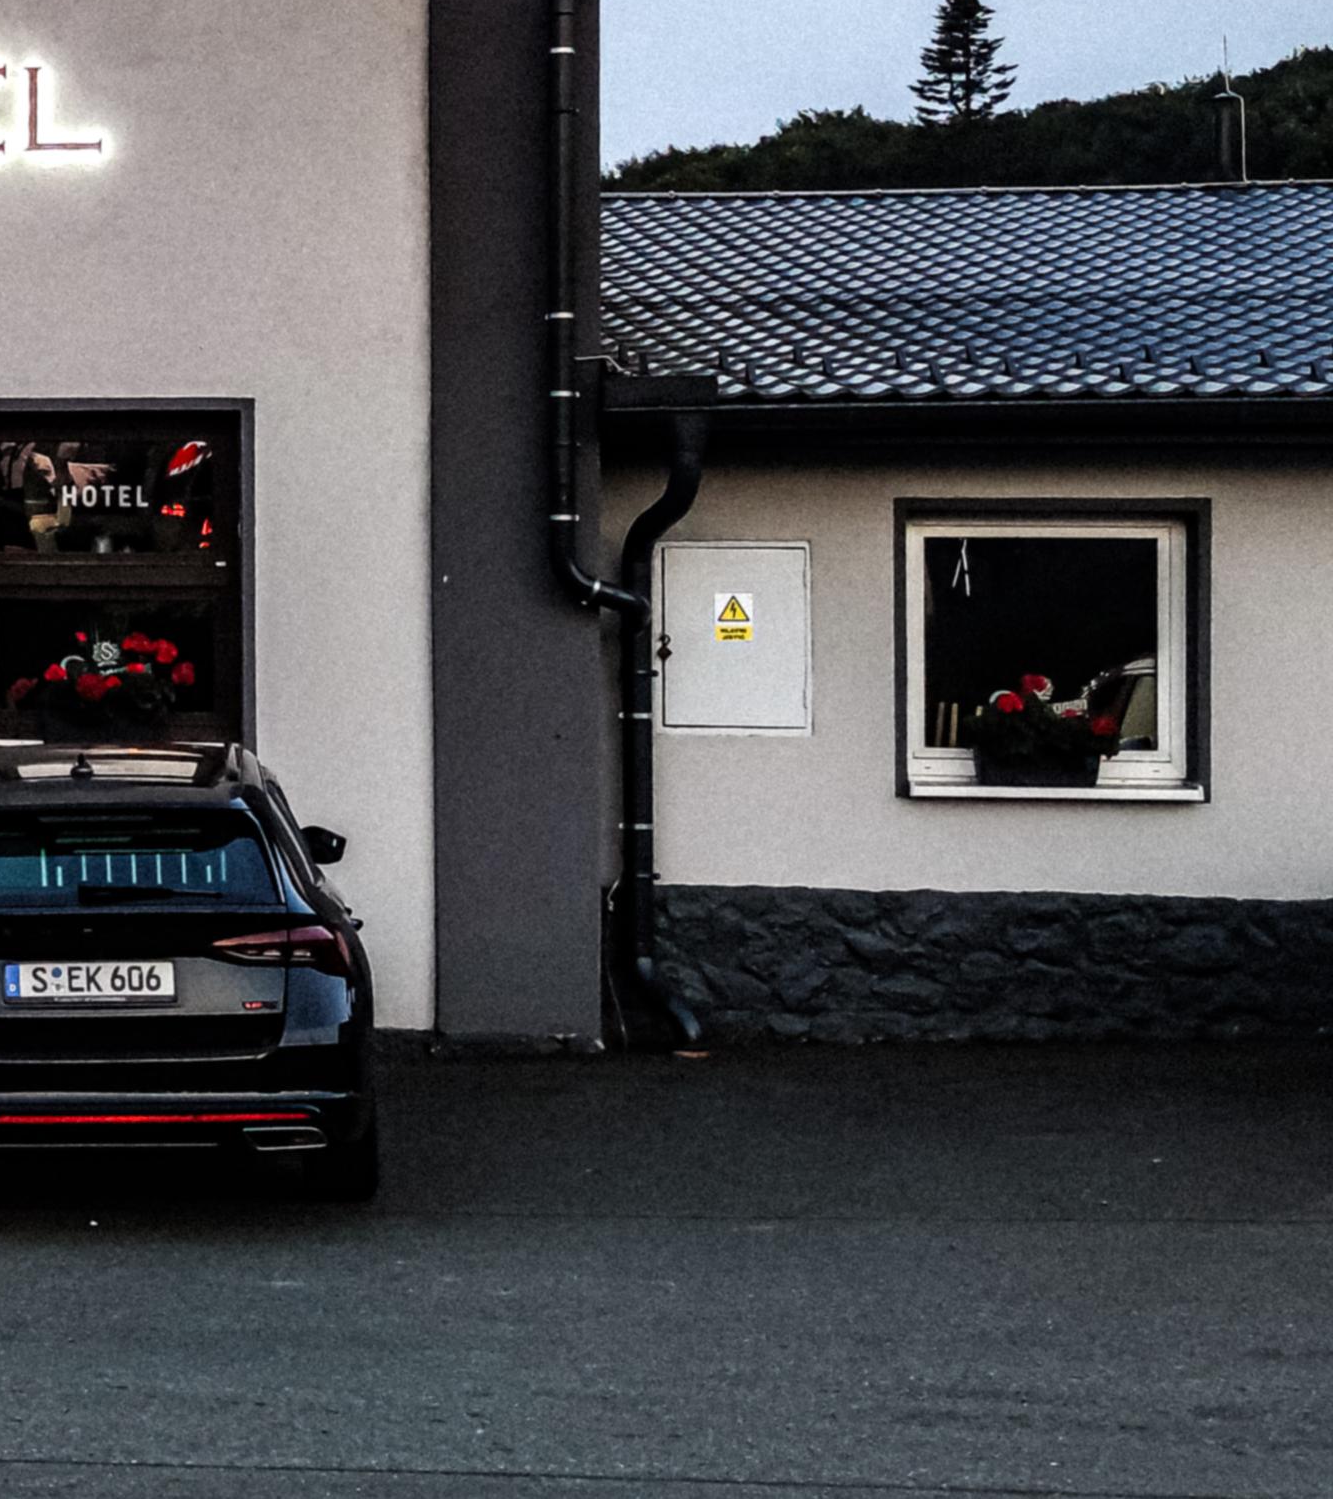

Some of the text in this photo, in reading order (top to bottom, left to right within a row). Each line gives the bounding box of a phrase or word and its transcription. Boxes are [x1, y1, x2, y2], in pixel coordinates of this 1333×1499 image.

[61, 484, 150, 508] HOTEL
[31, 966, 48, 993] S
[67, 966, 103, 993] EK
[110, 965, 162, 992] 606
